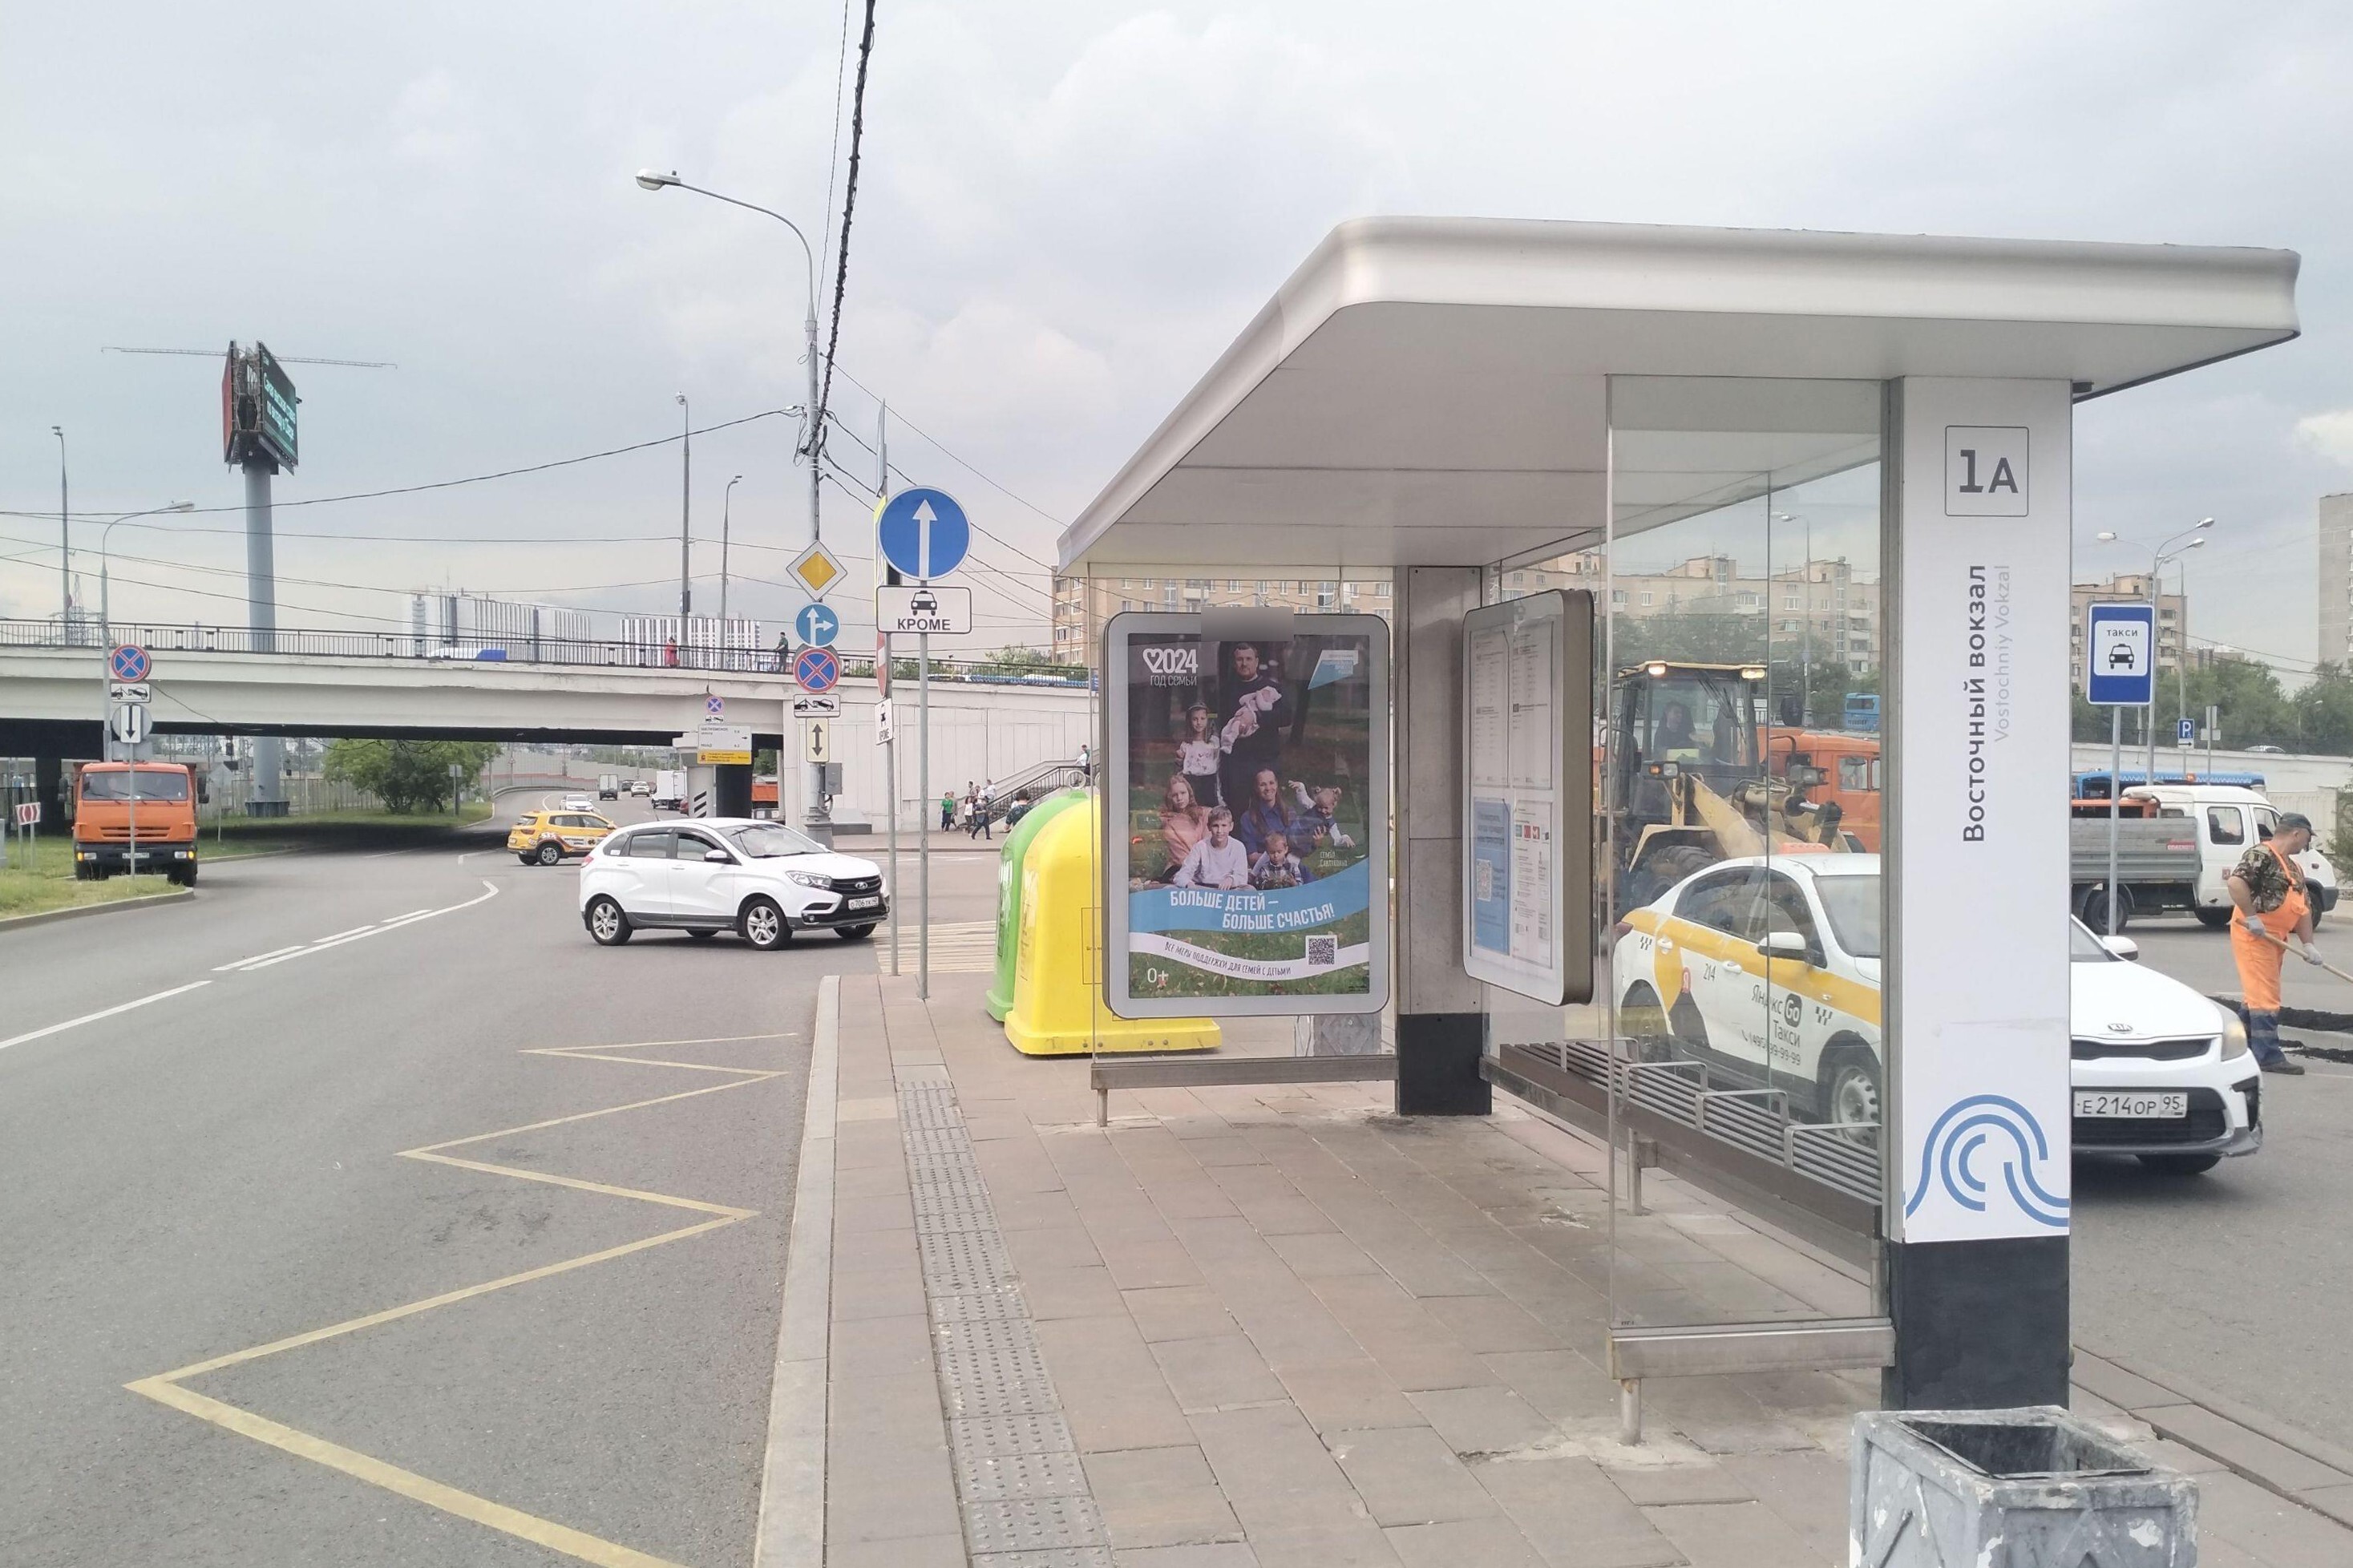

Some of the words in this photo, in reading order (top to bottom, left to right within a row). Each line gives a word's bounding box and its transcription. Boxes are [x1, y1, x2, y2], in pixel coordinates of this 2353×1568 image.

[1995, 564, 2010, 629] Vokzal
[897, 618, 951, 631] КРОМЕ
[1969, 564, 1986, 668] вокзал
[2106, 628, 2139, 637] такси
[1147, 648, 1199, 674] 2024
[1995, 633, 2013, 742] Vostochniy
[1963, 678, 1985, 843] Восточный
[1170, 890, 1223, 909] БОЛЬШЕ
[1224, 892, 1265, 911] ДЕТЕЙ
[1222, 912, 1275, 930] БОЛЬШЕ
[1276, 903, 1335, 929] СЧАСТЬЯ!
[1165, 941, 1175, 952] ВСЕ
[1175, 947, 1192, 959] МЕРЫ
[1192, 952, 1227, 969] ПОДДЕРЖКИ
[1227, 963, 1241, 972] ДЛЯ
[1242, 964, 1261, 976] СЕМЕЙ
[1266, 967, 1292, 977] ДЕТЬМИ
[1147, 968, 1169, 983] 0+
[1704, 964, 1716, 981] 214
[1785, 999, 1801, 1022] Go
[1773, 1020, 1801, 1048] Такси
[2083, 1097, 2157, 1115] Е214ОР
[2162, 1096, 2181, 1110] 95
